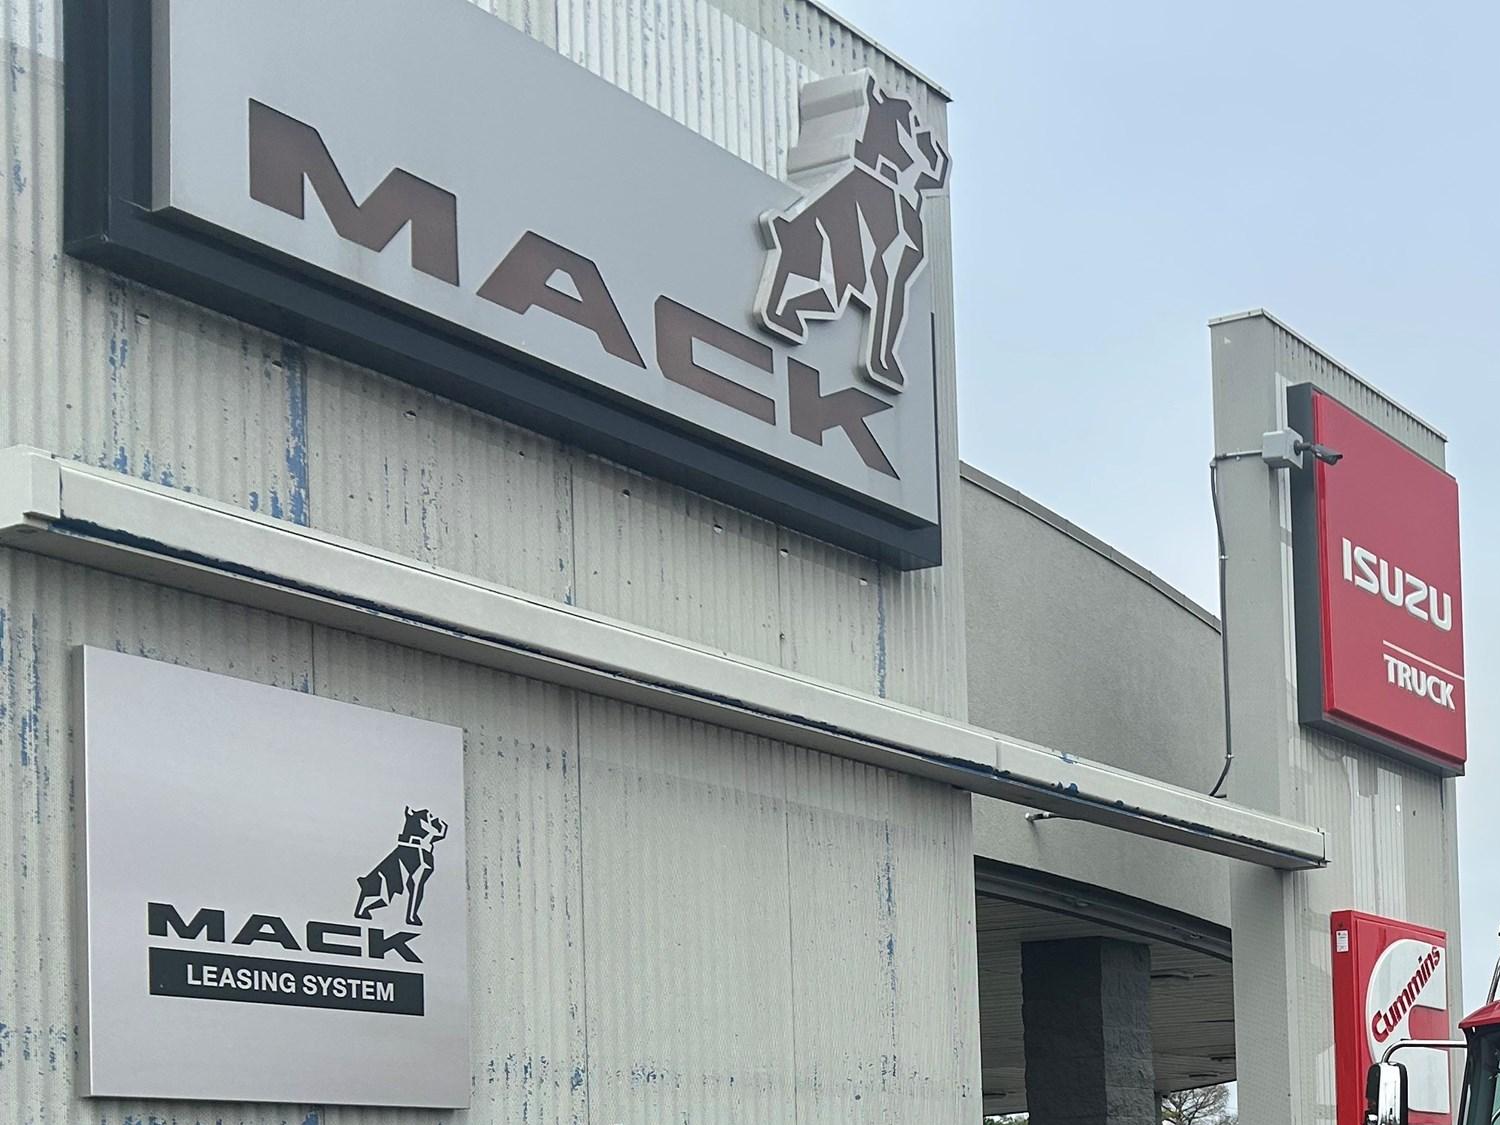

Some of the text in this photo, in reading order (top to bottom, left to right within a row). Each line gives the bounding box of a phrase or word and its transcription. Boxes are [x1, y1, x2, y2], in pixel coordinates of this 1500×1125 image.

[248, 97, 900, 480] MACK
[1342, 536, 1453, 632] ISUZU
[1383, 653, 1456, 711] TRUCK
[147, 901, 424, 964] MACK
[186, 963, 395, 1002] LEASING SYSTEM
[1371, 946, 1441, 1043] Cummins
